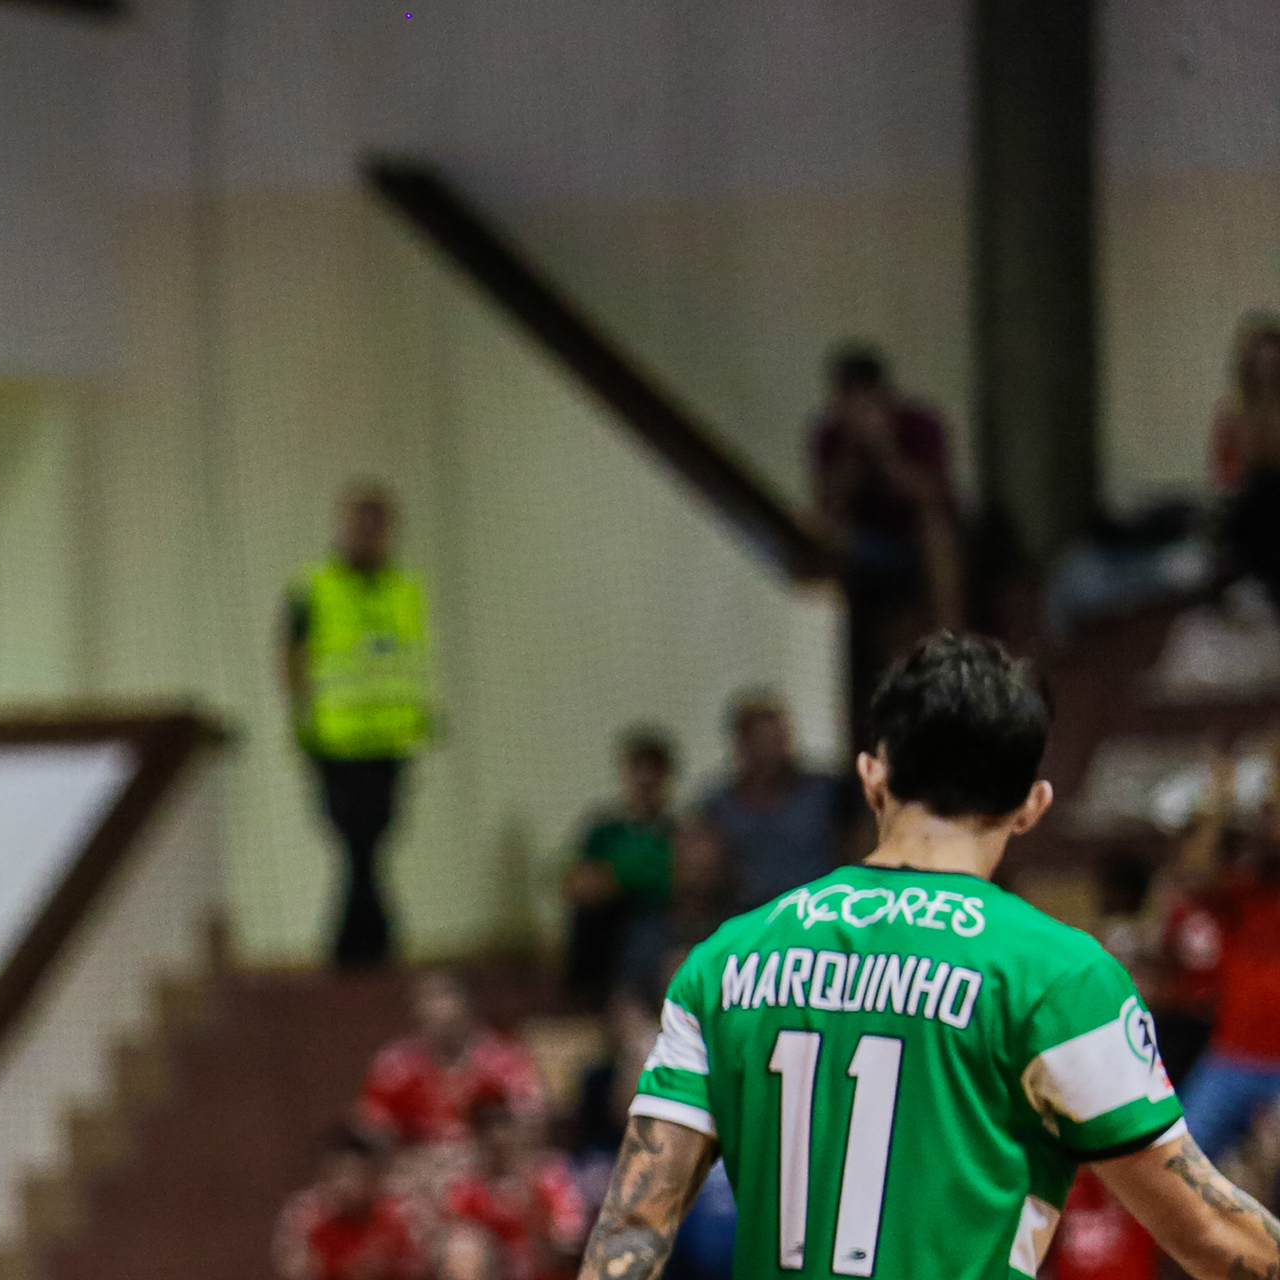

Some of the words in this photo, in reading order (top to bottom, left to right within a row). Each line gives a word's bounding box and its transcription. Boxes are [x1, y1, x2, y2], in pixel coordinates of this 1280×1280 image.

[765, 883, 986, 938] AÇORES
[721, 947, 983, 1030] MARQUINHO
[768, 1030, 903, 1278] 11
